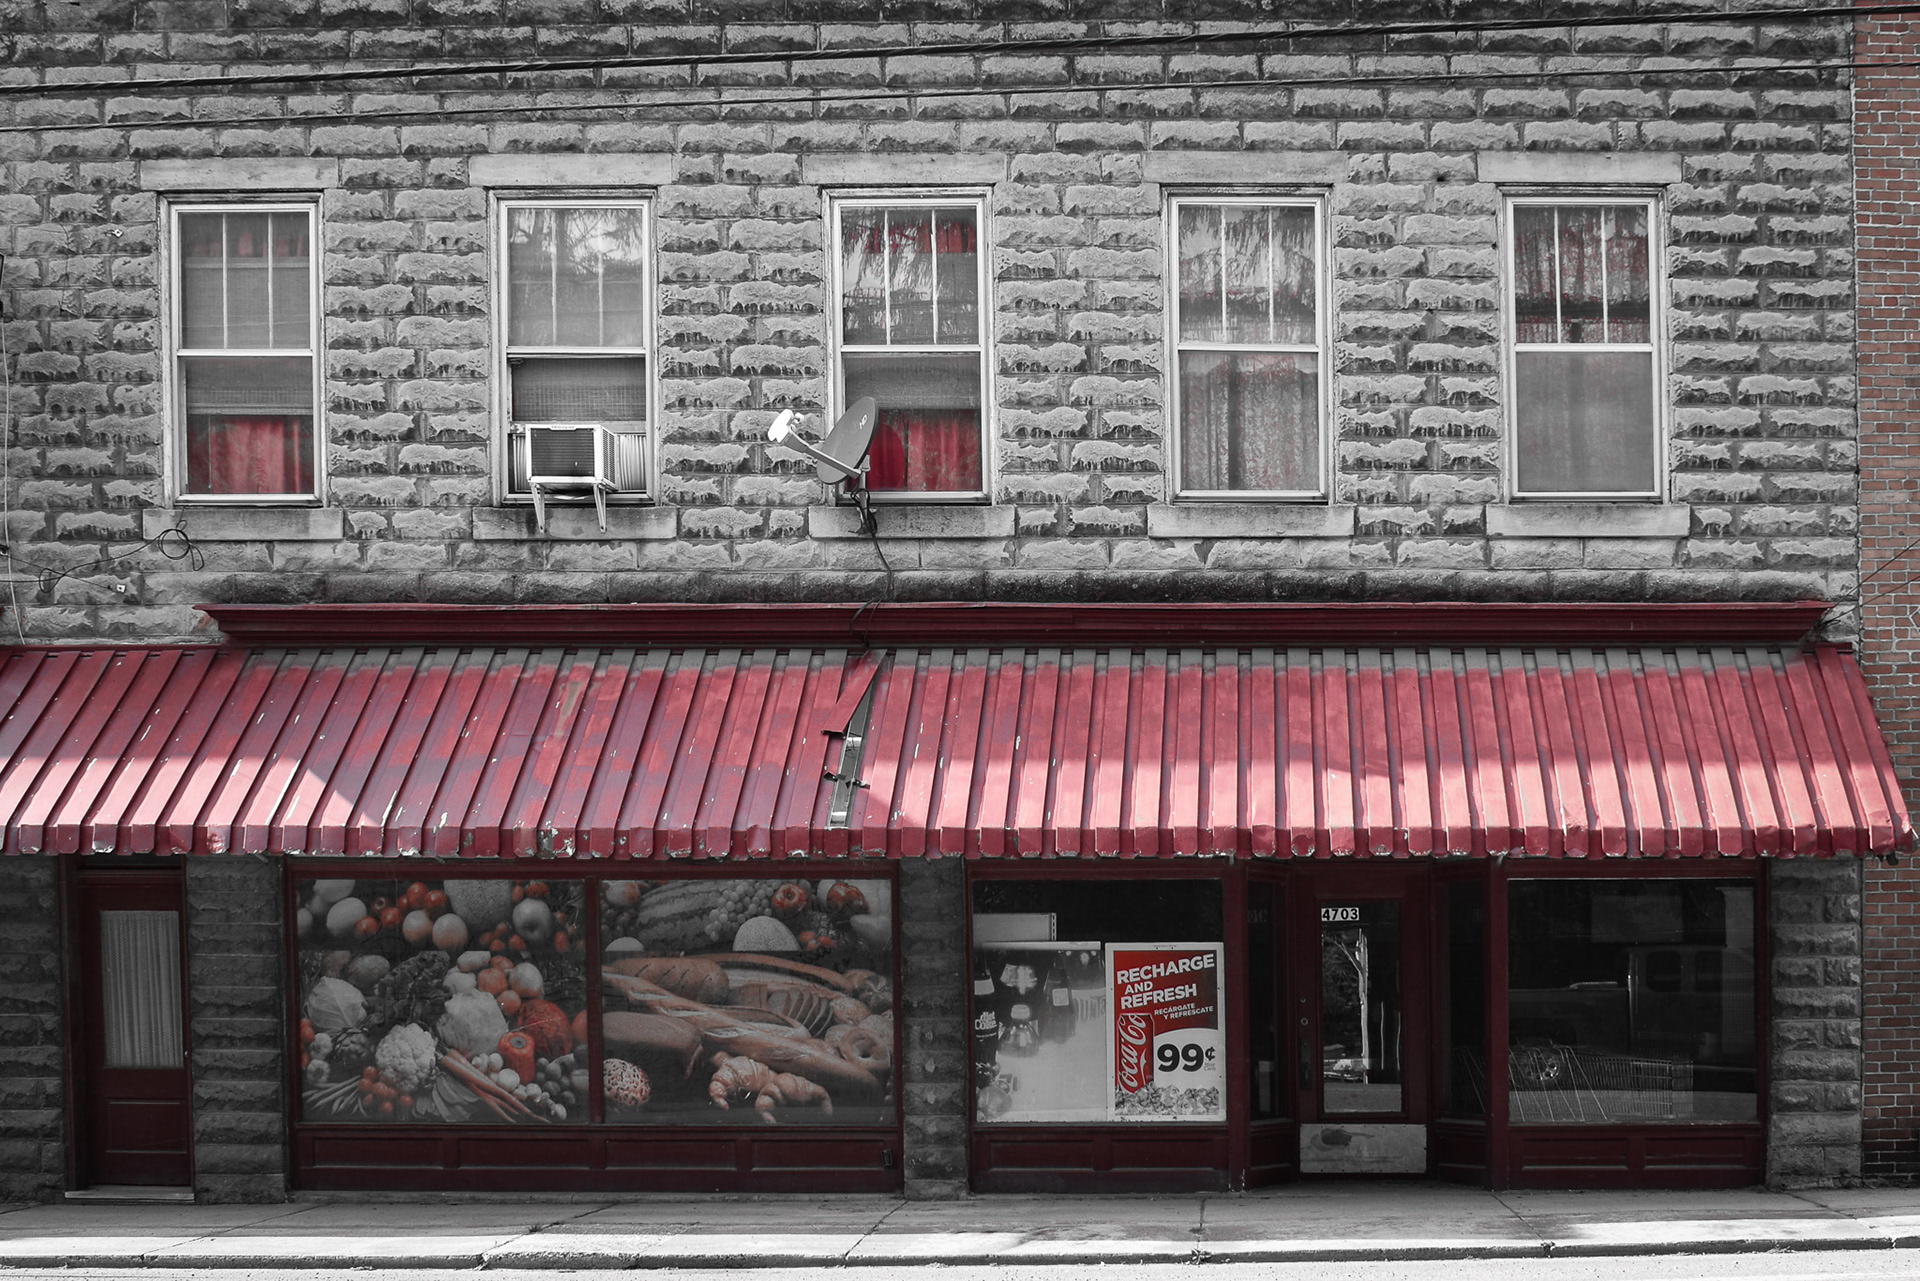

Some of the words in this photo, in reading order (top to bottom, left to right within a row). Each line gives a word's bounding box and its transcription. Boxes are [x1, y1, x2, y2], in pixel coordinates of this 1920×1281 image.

[1322, 908, 1358, 921] 4703
[1117, 954, 1214, 984] RECHARGE
[1124, 981, 1154, 995] AND
[1121, 984, 1197, 1010] REFRESH
[980, 1011, 996, 1020] diet
[975, 1019, 997, 1030] Coke
